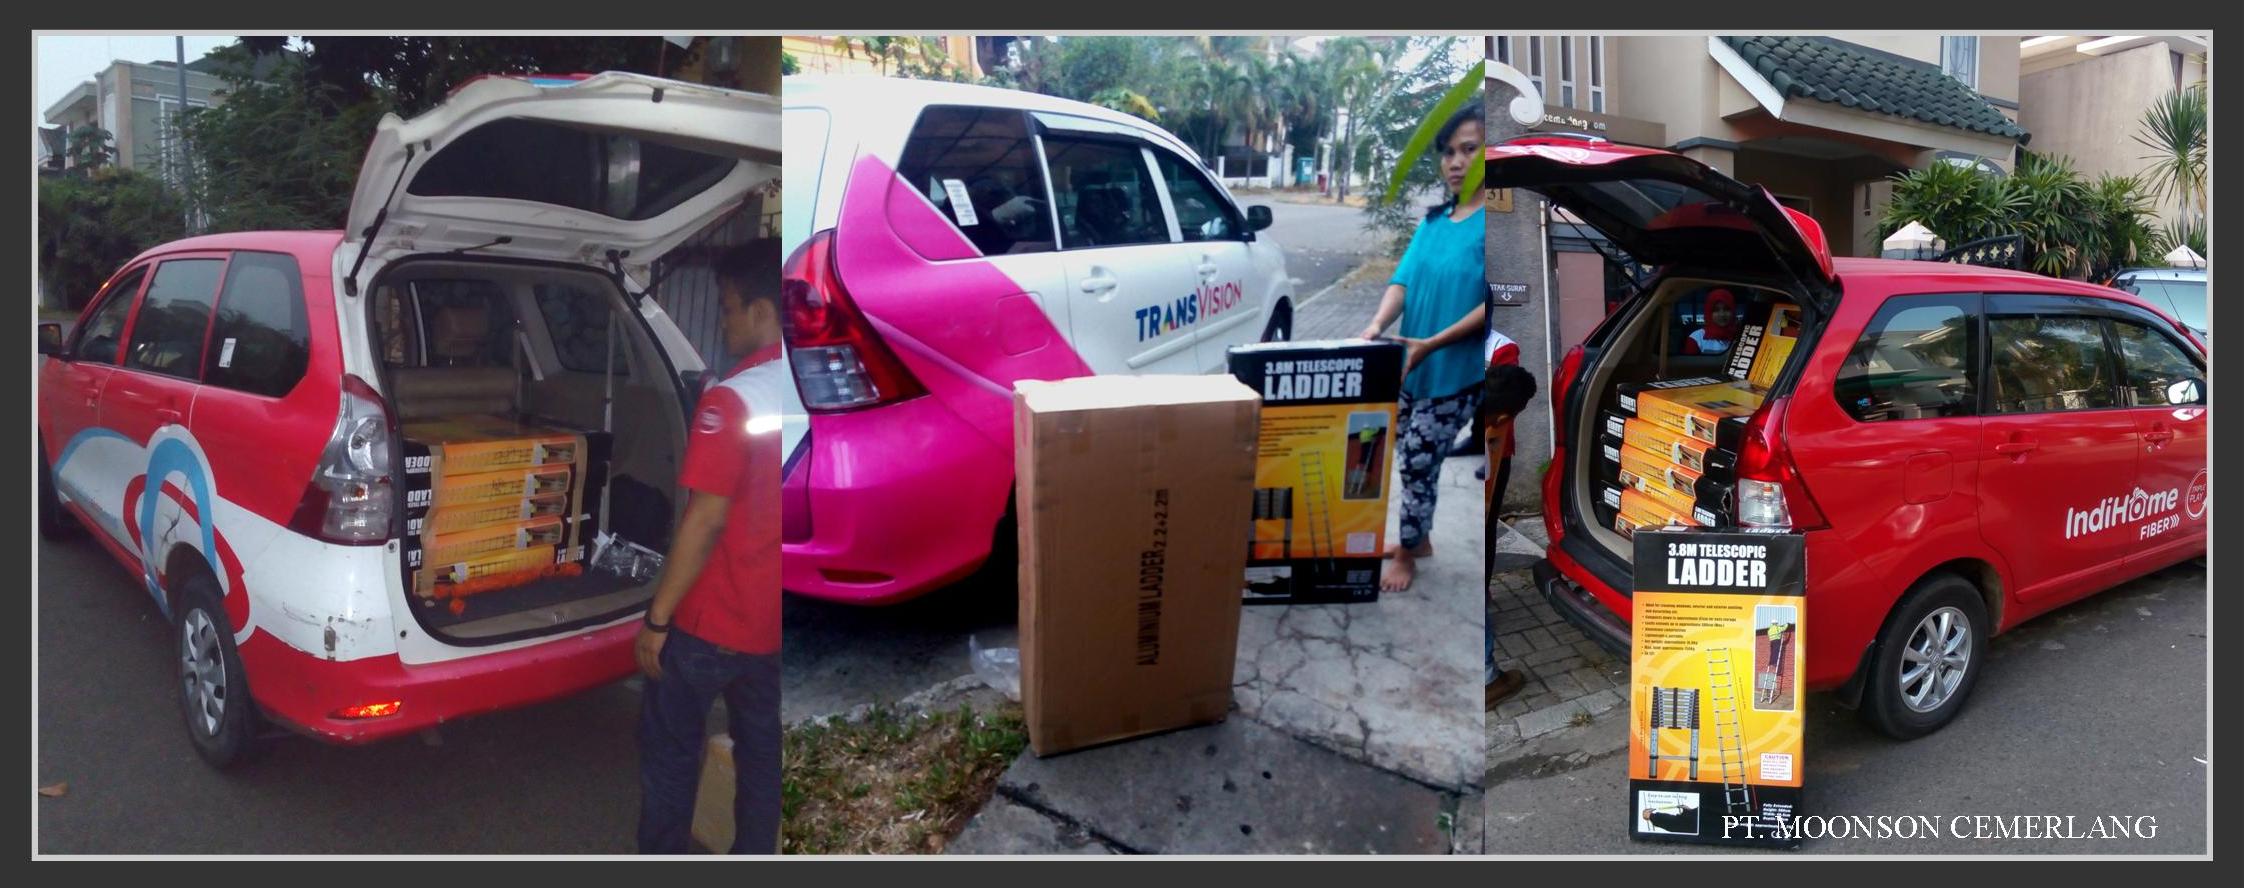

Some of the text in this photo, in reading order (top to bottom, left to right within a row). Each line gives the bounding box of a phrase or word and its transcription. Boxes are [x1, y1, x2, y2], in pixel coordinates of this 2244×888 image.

[1135, 280, 1242, 343] TRANSVISION
[1265, 358, 1364, 374] 3.8M TELESCOPIC
[1733, 325, 1763, 380] ADDER
[1264, 372, 1363, 400] LADDER
[2065, 487, 2179, 540] IndiHome
[2140, 517, 2170, 541] FIBER
[1668, 543, 1767, 558] 3.8M TELESCOPIC
[1140, 549, 1165, 600] LADDER
[1667, 557, 1767, 588] LADDER
[1137, 601, 1161, 666] ALUMINIUM
